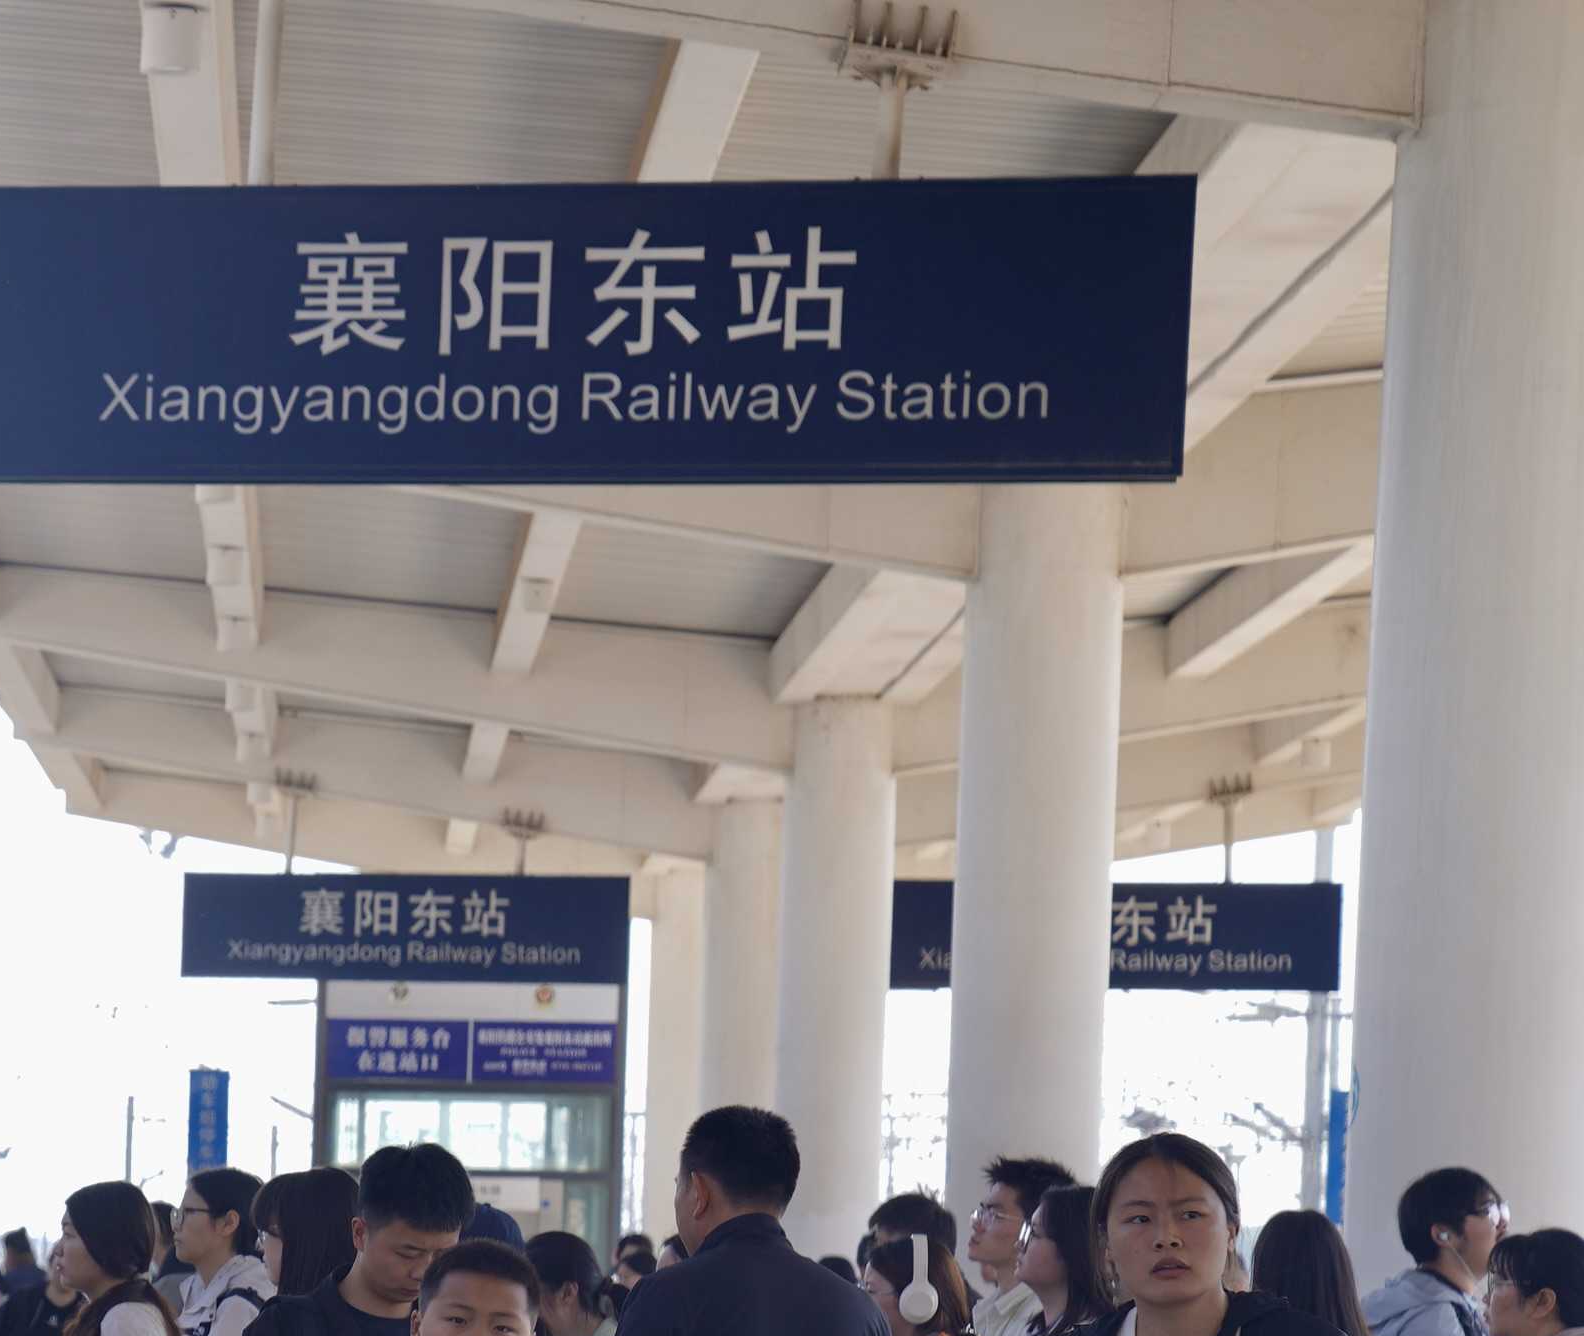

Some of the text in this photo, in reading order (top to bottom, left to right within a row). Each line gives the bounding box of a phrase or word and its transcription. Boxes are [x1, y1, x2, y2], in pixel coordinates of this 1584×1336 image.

[288, 226, 858, 356] 襄阳东站
[98, 370, 1049, 436] Xiangyangdong Railway Station
[299, 887, 510, 938] 襄阳东站
[1112, 895, 1218, 946] 东站
[227, 939, 581, 967] Xiangyangdong Railway Station
[1110, 949, 1293, 977] Railway Station
